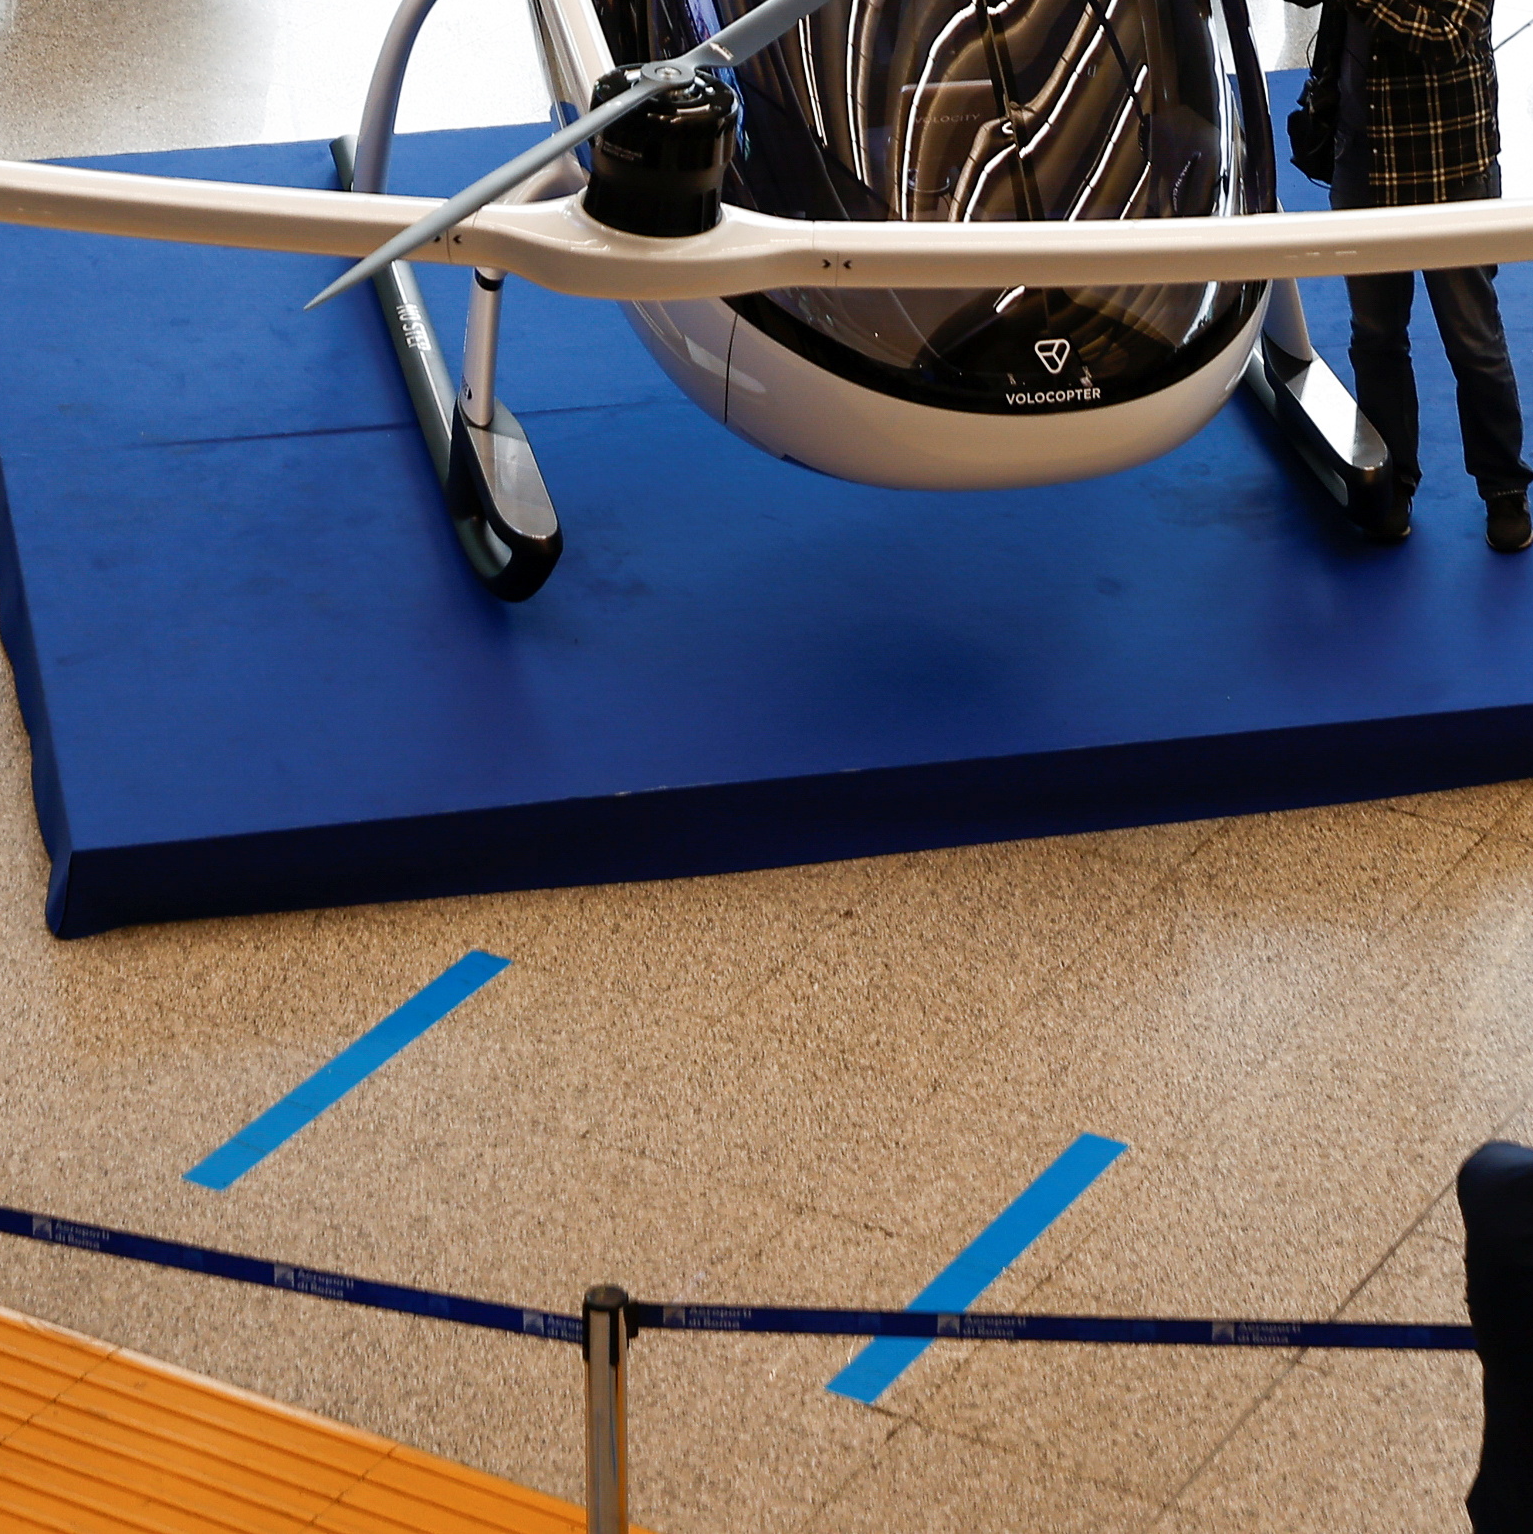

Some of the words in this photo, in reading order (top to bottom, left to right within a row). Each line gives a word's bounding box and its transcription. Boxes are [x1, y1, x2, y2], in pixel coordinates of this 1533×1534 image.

[1005, 387, 1102, 406] VOLOCOPTER
[55, 1220, 110, 1241] Aeroporti
[55, 1232, 66, 1243] di
[67, 1233, 101, 1251] Roma
[296, 1267, 354, 1290] Aeroporti
[297, 1281, 309, 1291] di
[310, 1282, 344, 1297] Roma
[688, 1306, 752, 1319] Aeroporti
[688, 1317, 701, 1327] di
[703, 1318, 741, 1329] Roma
[964, 1316, 1027, 1328] Aeroporti
[1238, 1322, 1301, 1334] Aeroporti
[963, 1327, 976, 1336] di
[978, 1327, 1014, 1337] Roma
[1237, 1333, 1250, 1343] di
[1252, 1334, 1290, 1345] Roma
